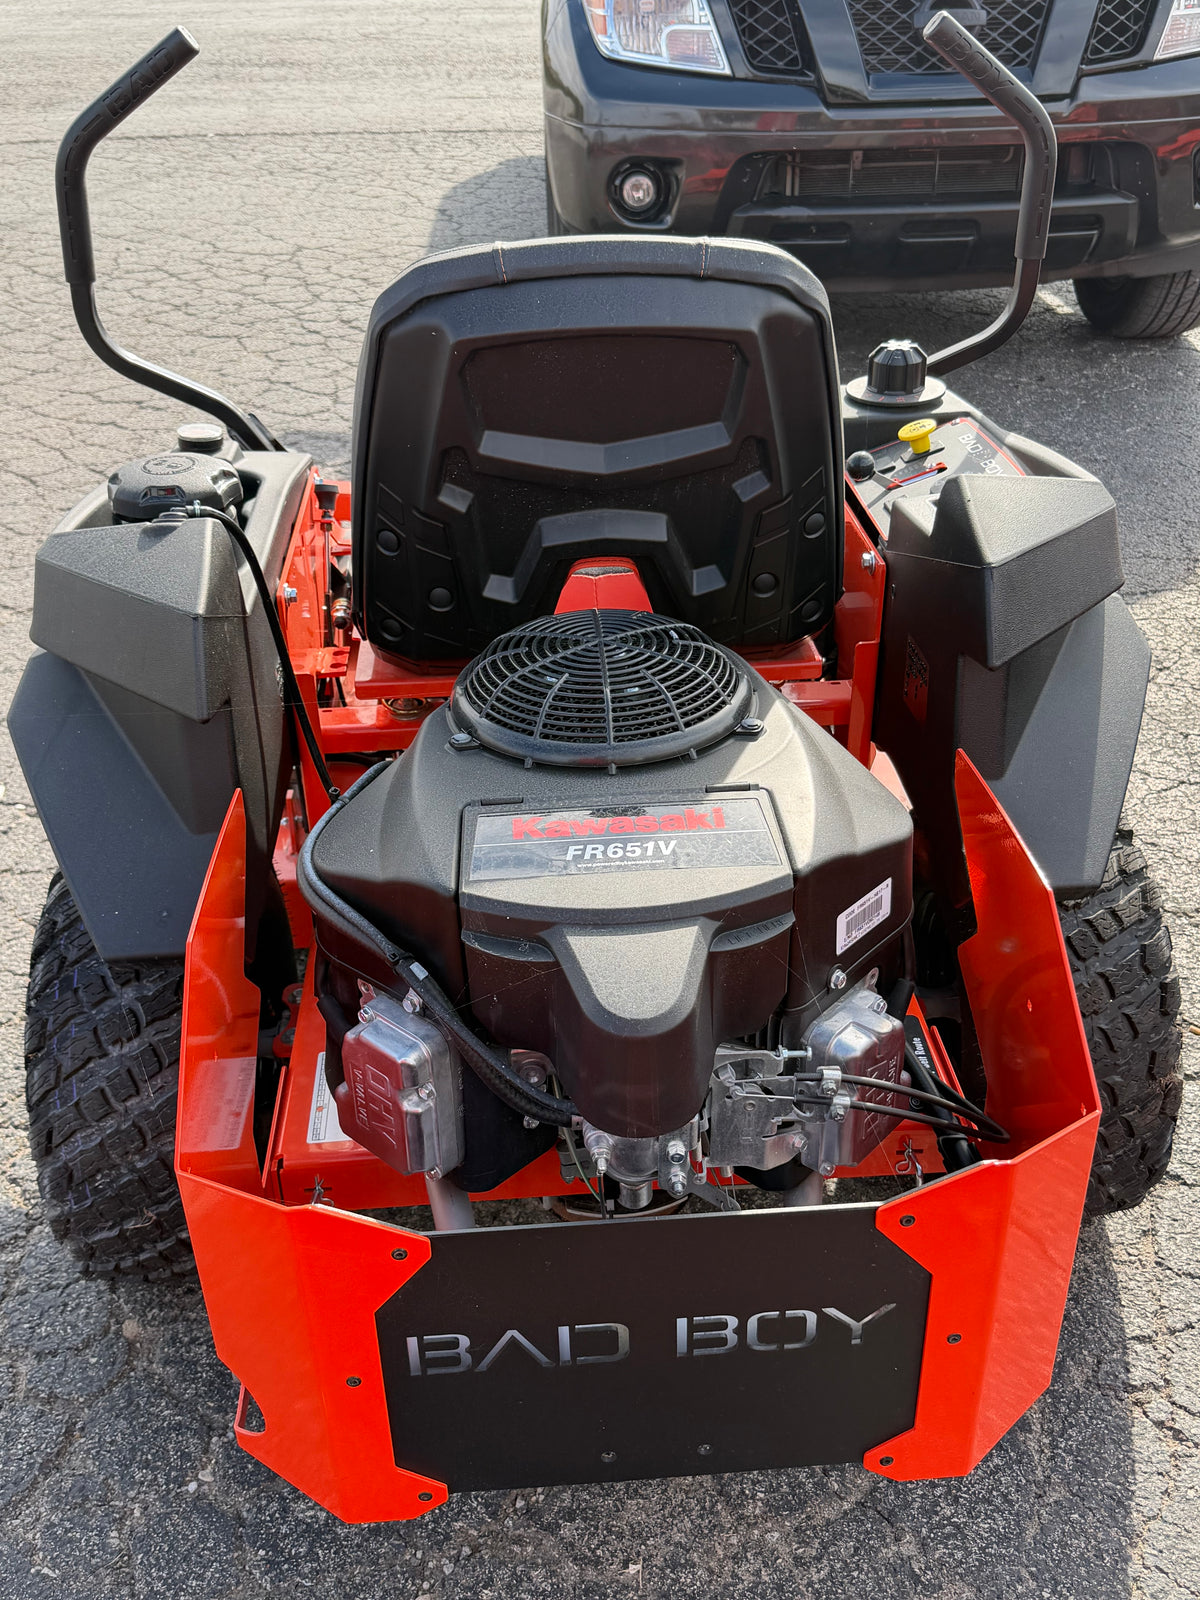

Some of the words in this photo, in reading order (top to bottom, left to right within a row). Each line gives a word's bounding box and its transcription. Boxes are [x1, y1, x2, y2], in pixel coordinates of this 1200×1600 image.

[102, 46, 174, 118] BAD
[943, 30, 1015, 93] BOY
[958, 433, 983, 454] BAD
[511, 807, 727, 840] Kawasaki
[565, 840, 678, 861] FR651V
[912, 1037, 926, 1055] Route
[365, 1063, 398, 1150] OHV
[406, 1322, 631, 1377] BAD
[675, 1302, 897, 1358] BOY
